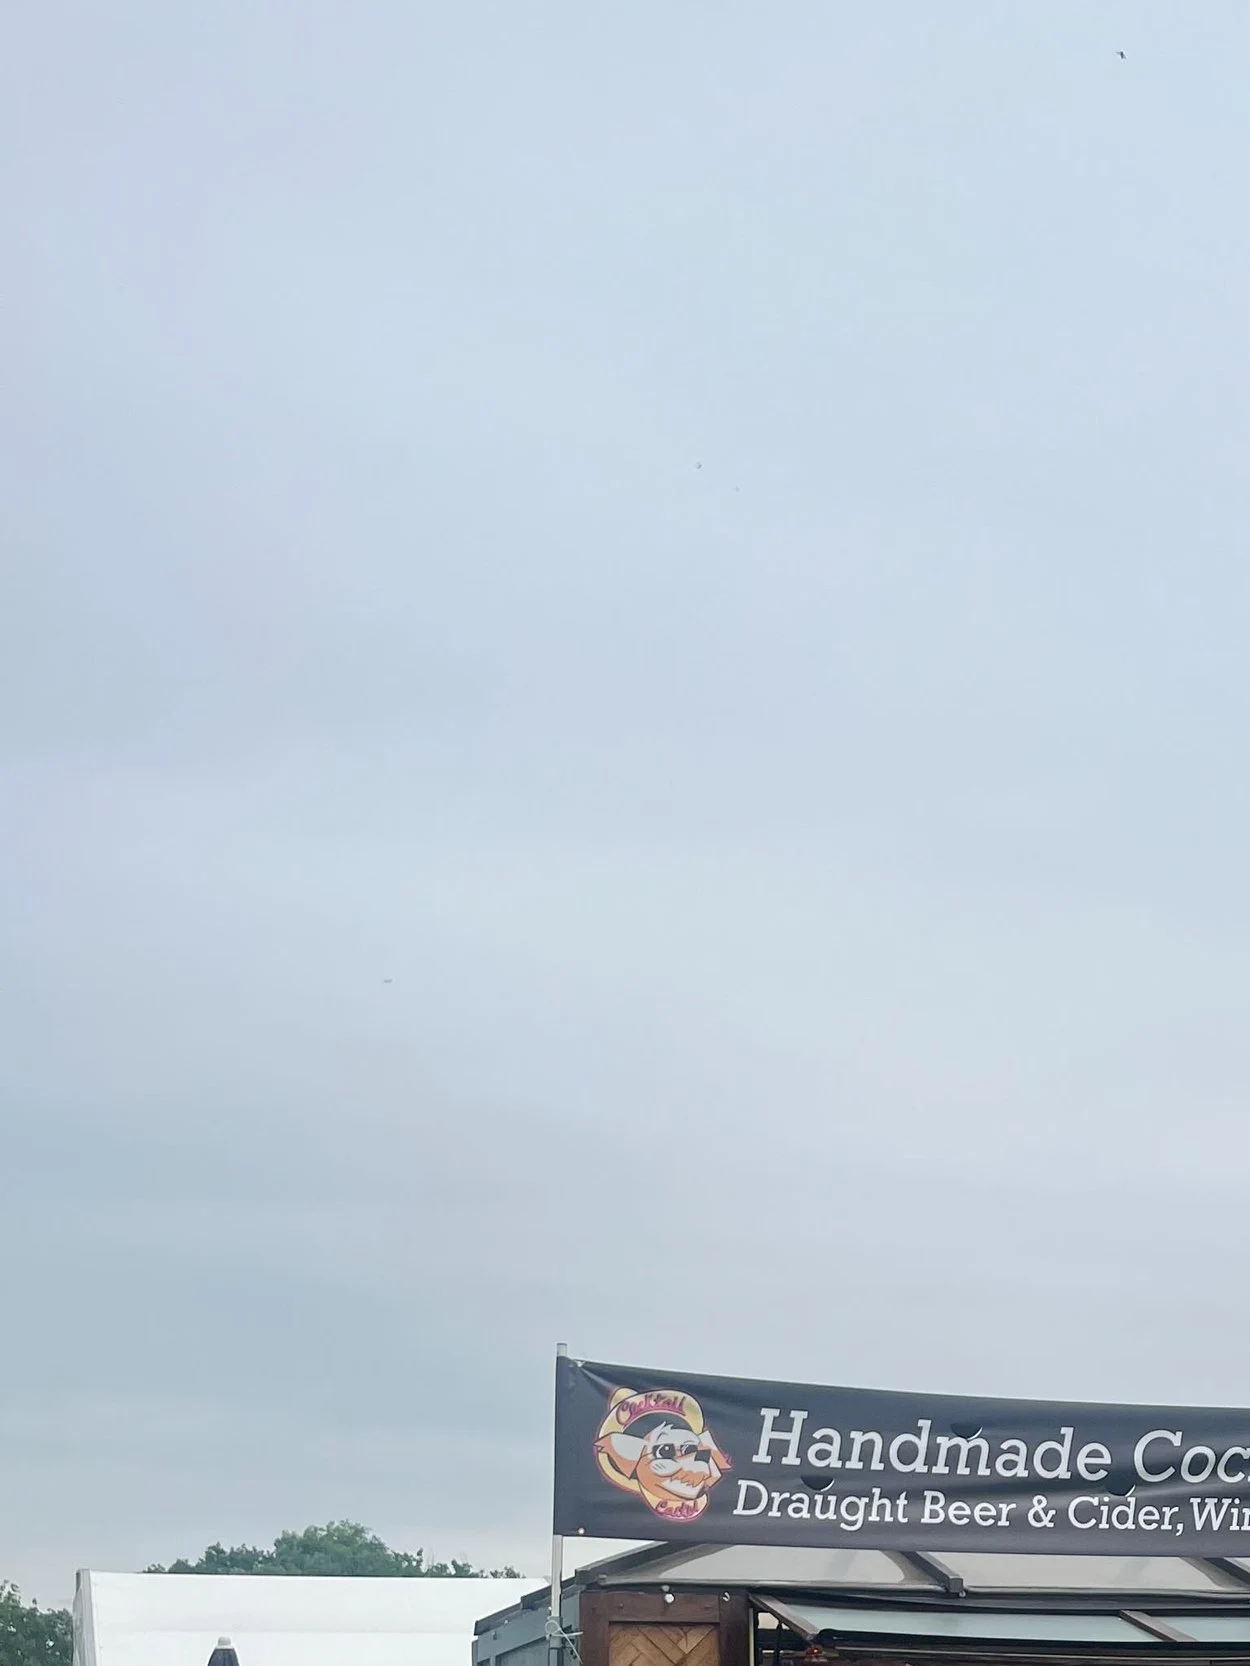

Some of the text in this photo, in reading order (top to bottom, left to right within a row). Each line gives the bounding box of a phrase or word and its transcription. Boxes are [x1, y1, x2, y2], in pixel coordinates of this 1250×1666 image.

[752, 1407, 1112, 1481] Handmade
[733, 1480, 909, 1531] Draught
[921, 1490, 1016, 1527] Beer
[1027, 1494, 1056, 1528] &
